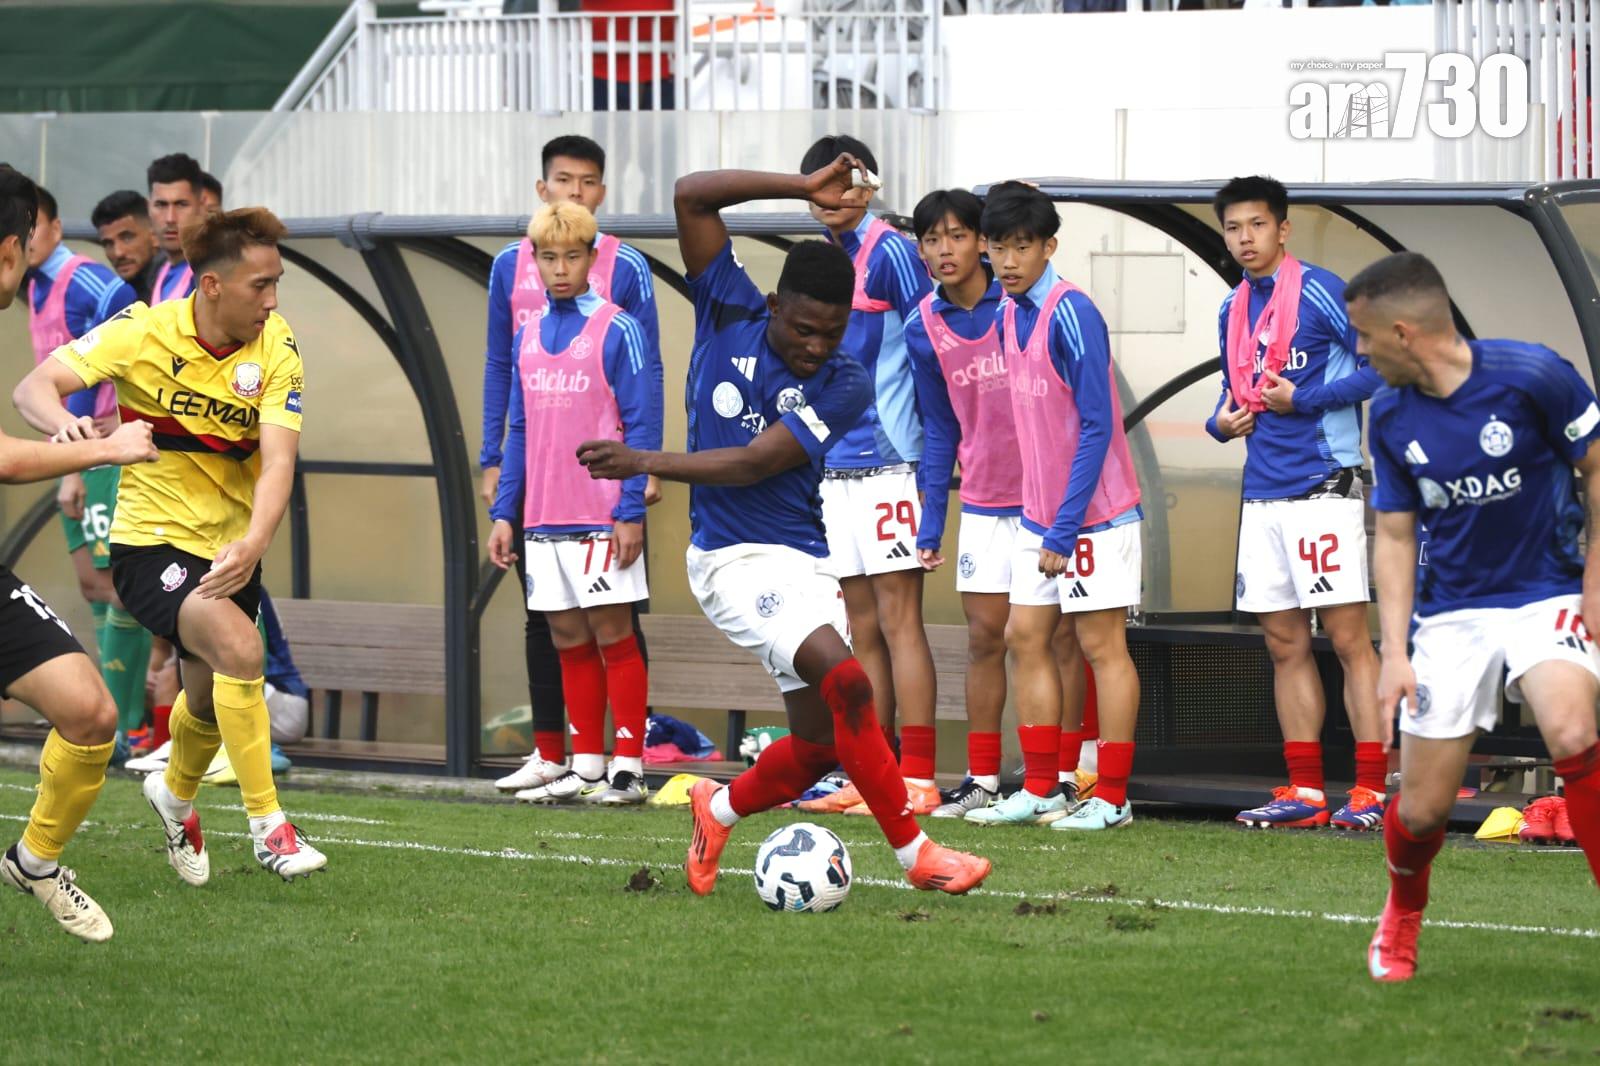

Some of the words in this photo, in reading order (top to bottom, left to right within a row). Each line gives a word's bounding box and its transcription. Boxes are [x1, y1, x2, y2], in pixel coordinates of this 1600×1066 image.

[1445, 467, 1522, 500] XDAG
[875, 500, 917, 541] 29
[579, 538, 612, 575] 77
[1065, 538, 1095, 578] 8
[1298, 533, 1341, 574] 42
